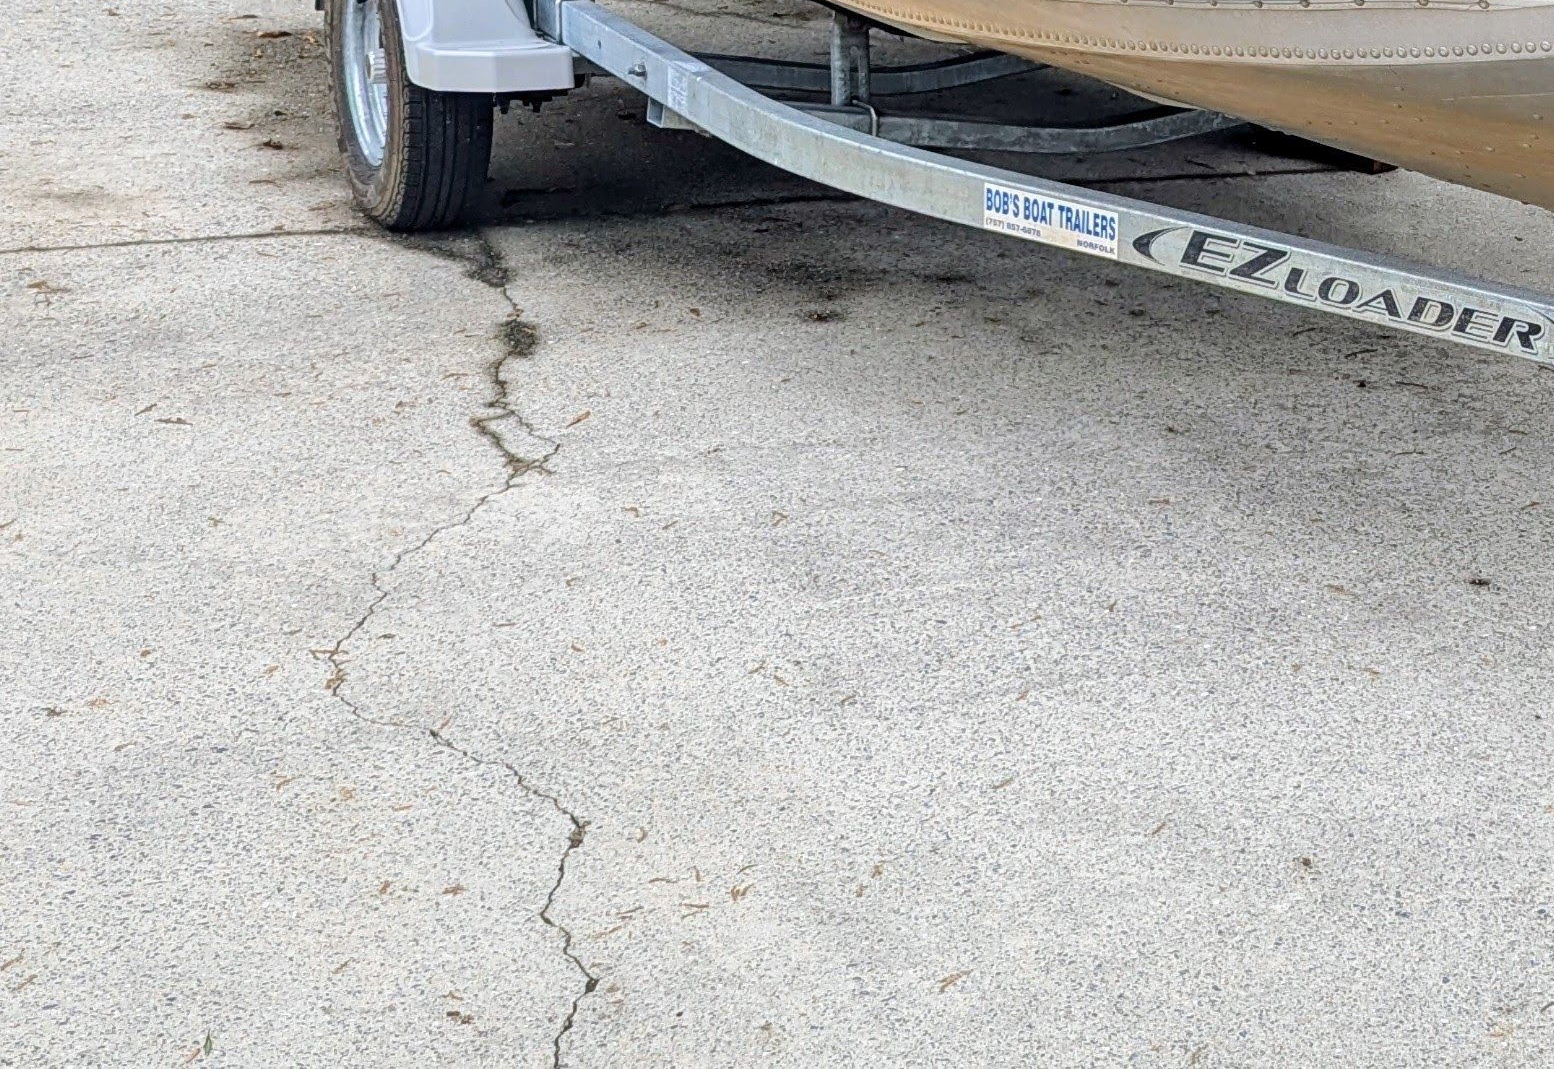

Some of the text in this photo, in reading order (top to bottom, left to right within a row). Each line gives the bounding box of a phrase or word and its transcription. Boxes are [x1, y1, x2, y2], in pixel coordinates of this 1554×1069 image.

[986, 187, 1116, 241] BOB'S BOAT TRAILERS
[1076, 238, 1115, 255] NORFOLK
